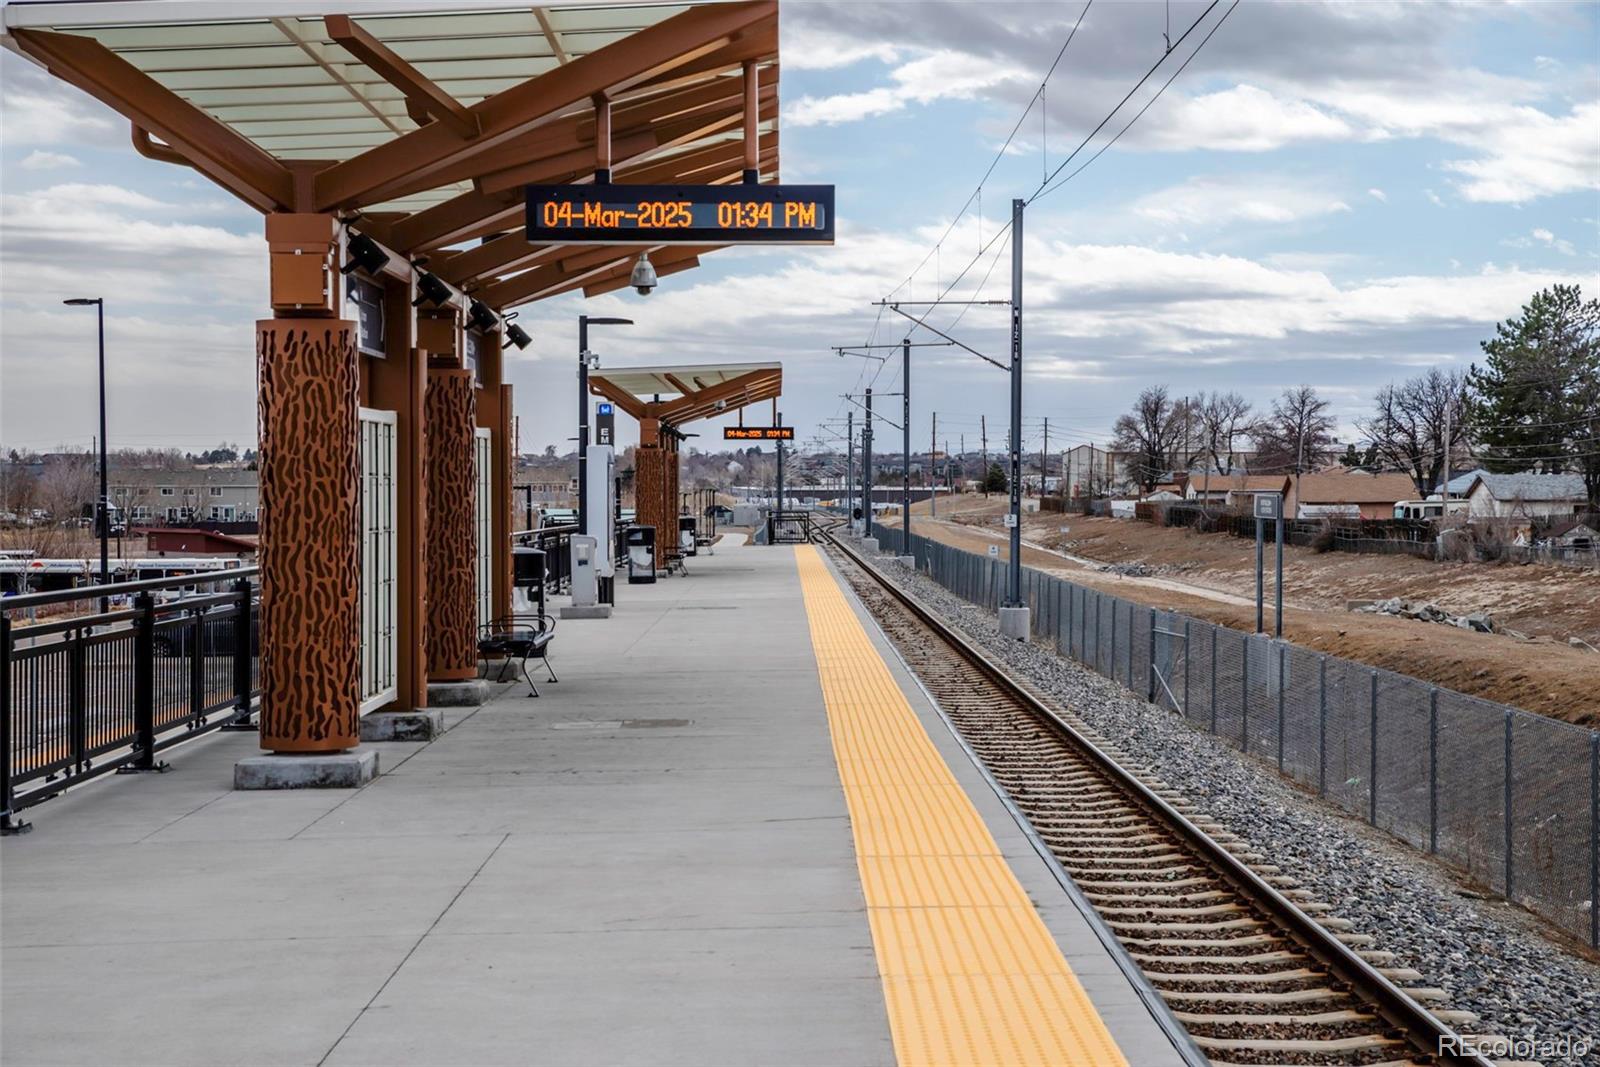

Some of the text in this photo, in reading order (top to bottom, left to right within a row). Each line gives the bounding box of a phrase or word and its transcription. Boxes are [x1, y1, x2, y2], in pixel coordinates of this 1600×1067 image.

[543, 202, 815, 228] 04-Mar-2025 01:34 PM
